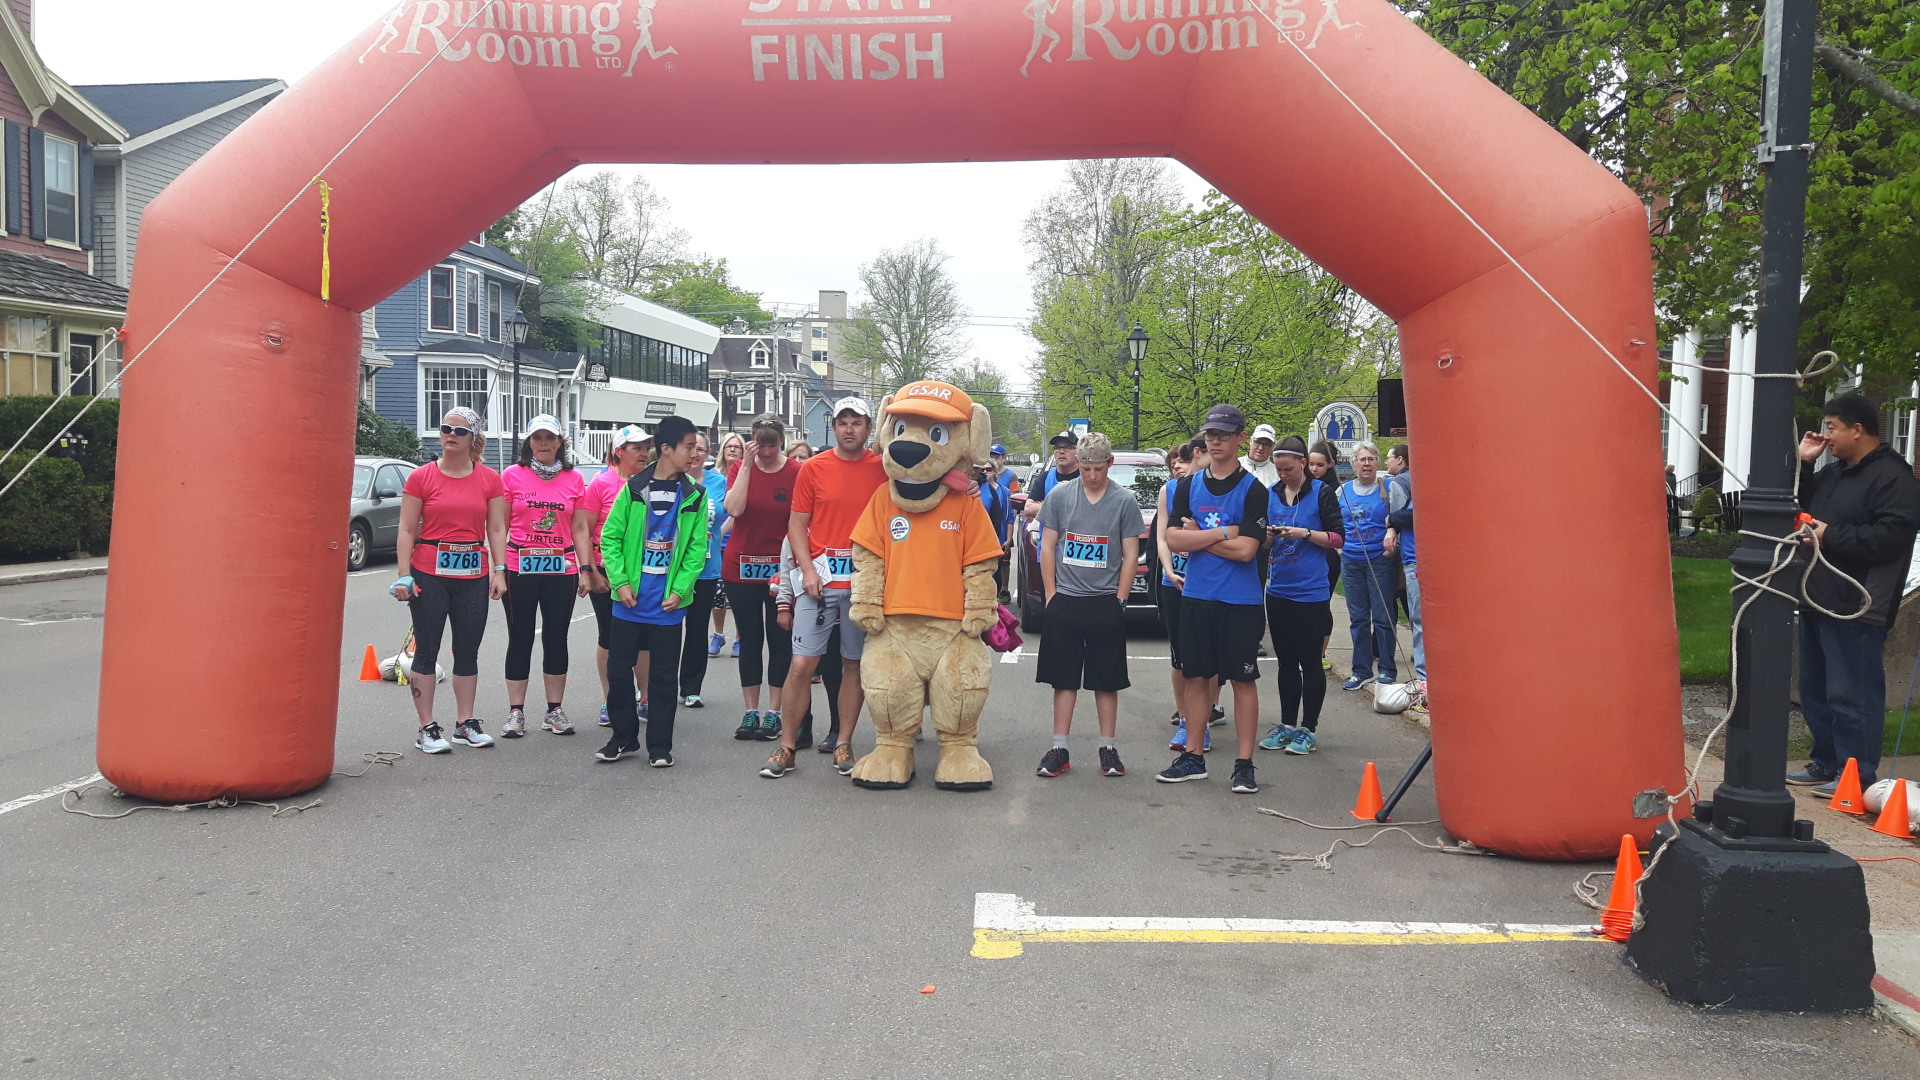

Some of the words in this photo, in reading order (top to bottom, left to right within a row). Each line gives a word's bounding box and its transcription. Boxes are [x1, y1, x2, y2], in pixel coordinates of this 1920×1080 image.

[596, 57, 624, 69] LTD.
[751, 32, 945, 81] FINISH
[908, 385, 952, 400] GSAR
[517, 491, 537, 502] SLOW
[940, 520, 960, 532] GSAR
[525, 533, 564, 544] TURTLES
[1066, 541, 1104, 561] 3724
[440, 552, 479, 569] 3768
[522, 556, 561, 572] 3720
[744, 563, 779, 578] 3721
